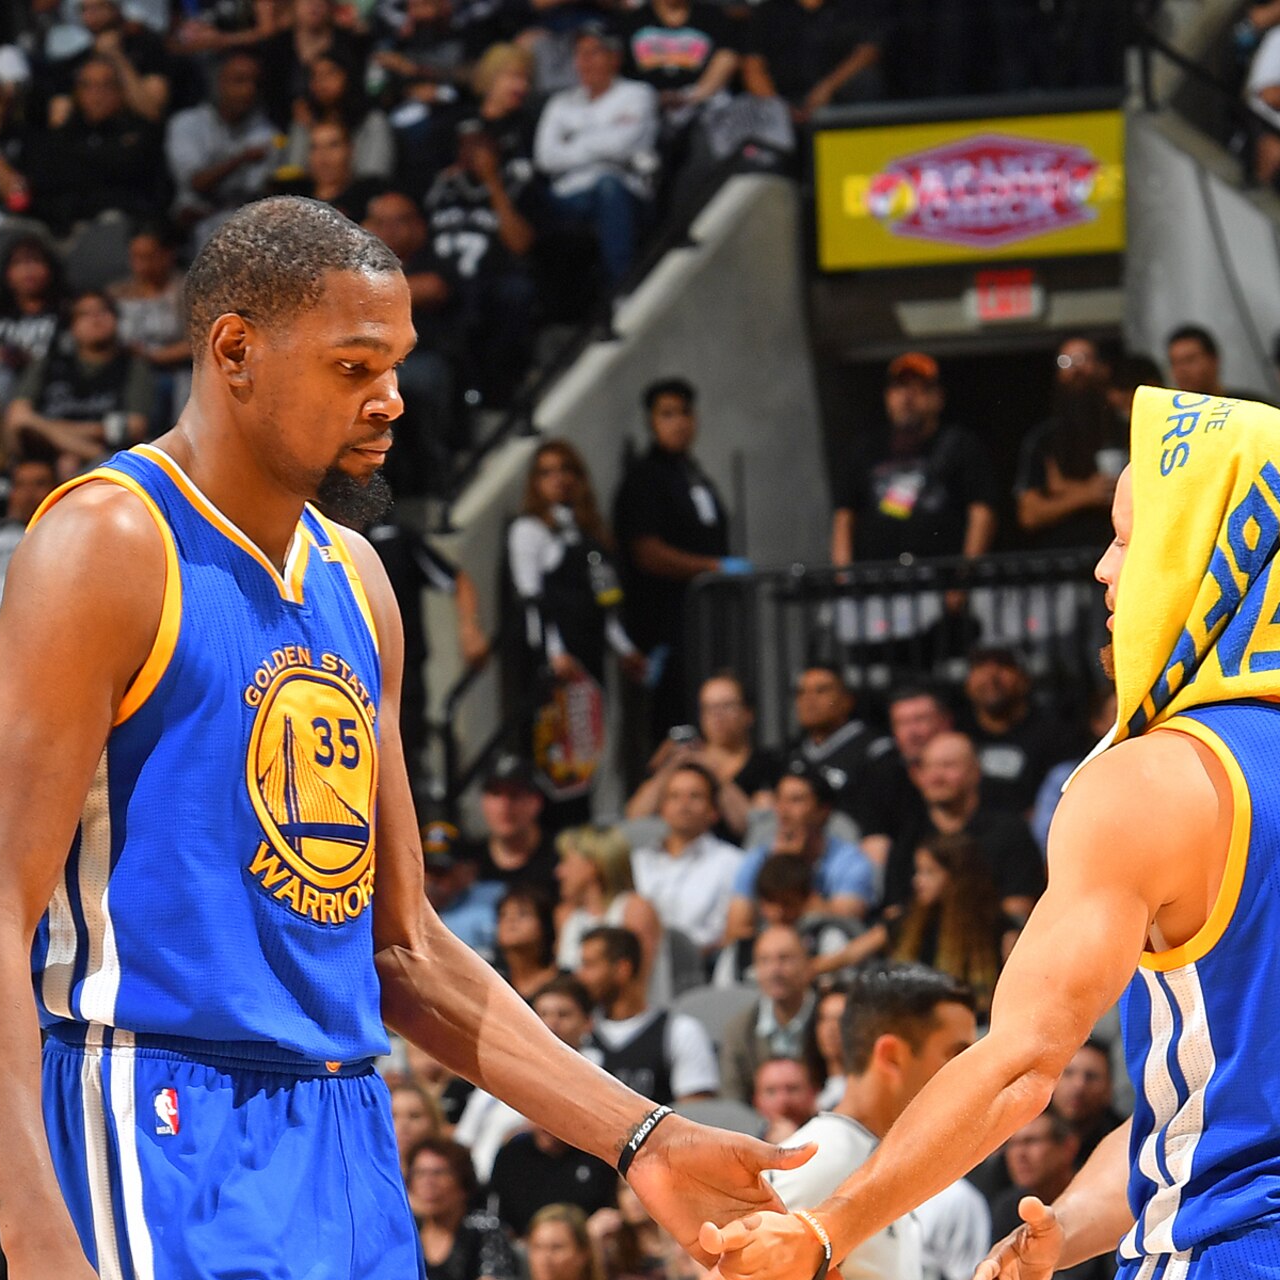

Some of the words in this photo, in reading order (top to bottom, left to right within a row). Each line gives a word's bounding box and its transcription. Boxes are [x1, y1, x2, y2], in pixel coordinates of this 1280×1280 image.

[244, 645, 312, 707] GOLDEN
[321, 652, 377, 724] STATE
[311, 716, 360, 770] 35
